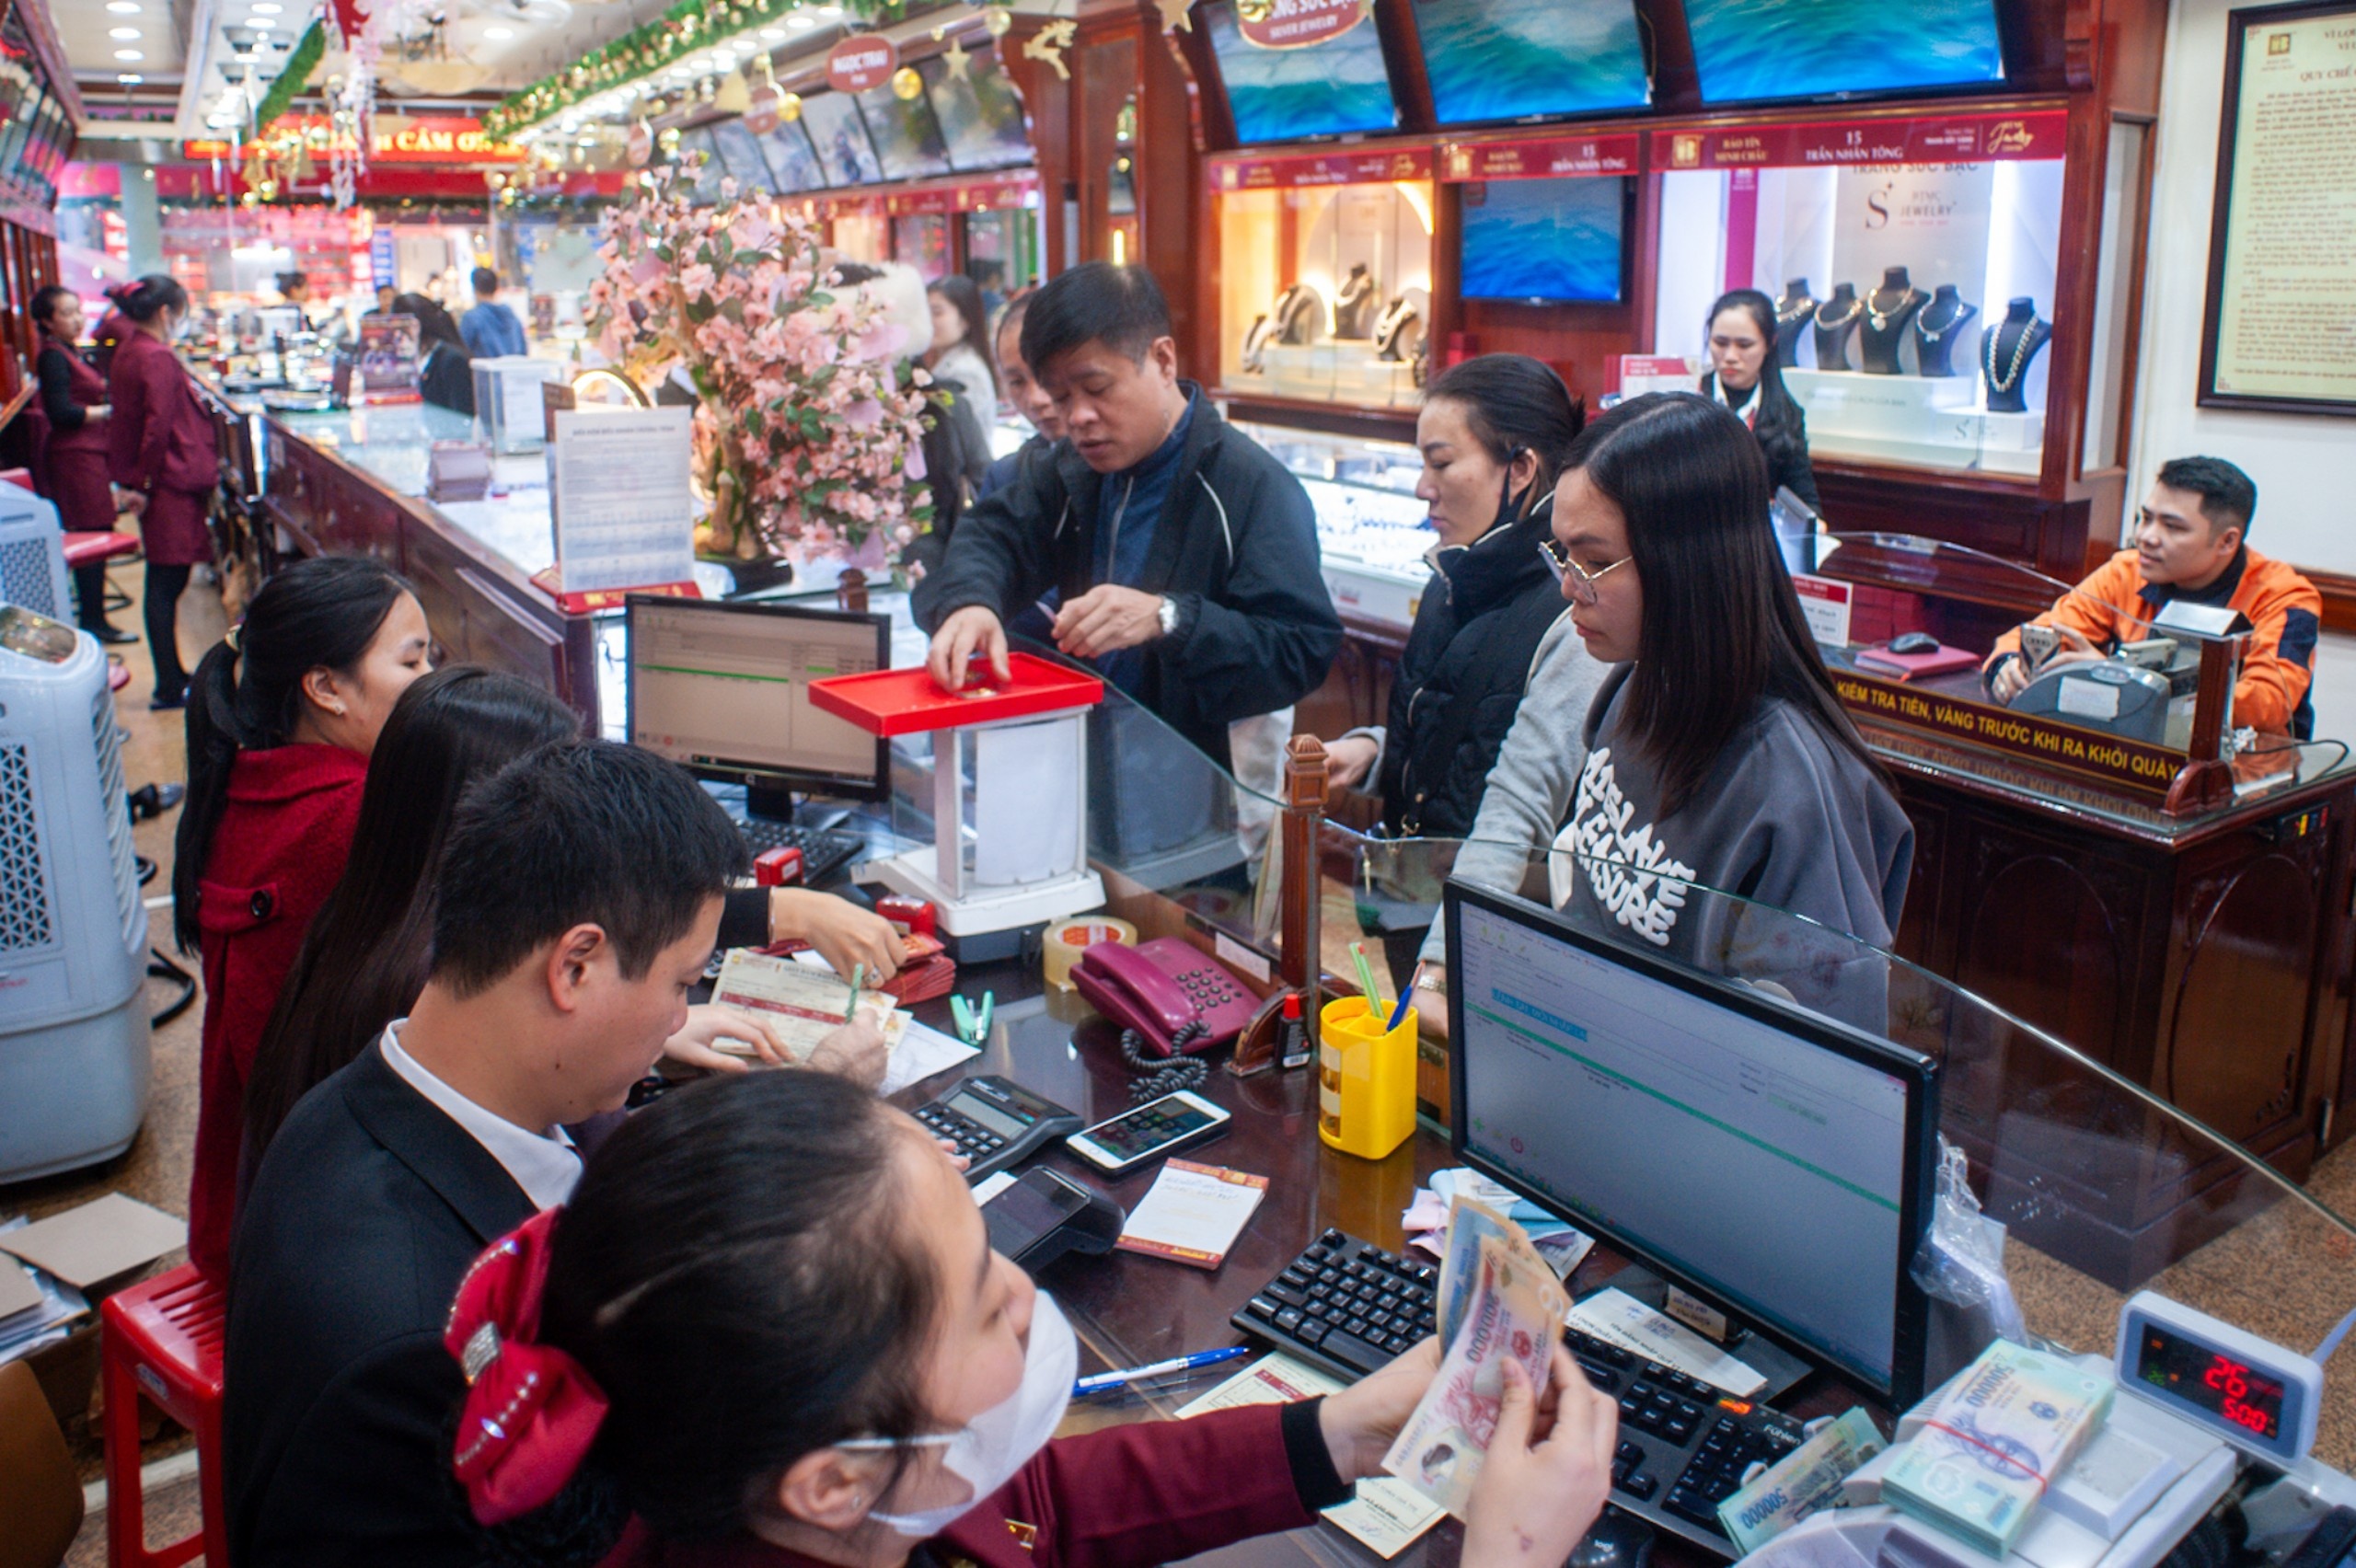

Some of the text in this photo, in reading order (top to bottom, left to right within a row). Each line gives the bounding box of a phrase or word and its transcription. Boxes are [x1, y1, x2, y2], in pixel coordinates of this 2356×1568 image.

[1846, 130, 1862, 145] 15
[1872, 144, 1903, 159] TÔNG
[1900, 204, 1953, 217] JEWELRY
[1837, 681, 2179, 780] KIỂM TRA TIỀN, VÀNG TRƯỚC KHI RA KHỎI QUẦY
[2204, 1354, 2249, 1399] 26
[2223, 1397, 2268, 1433] 500
[1740, 1487, 1788, 1530] 500000
